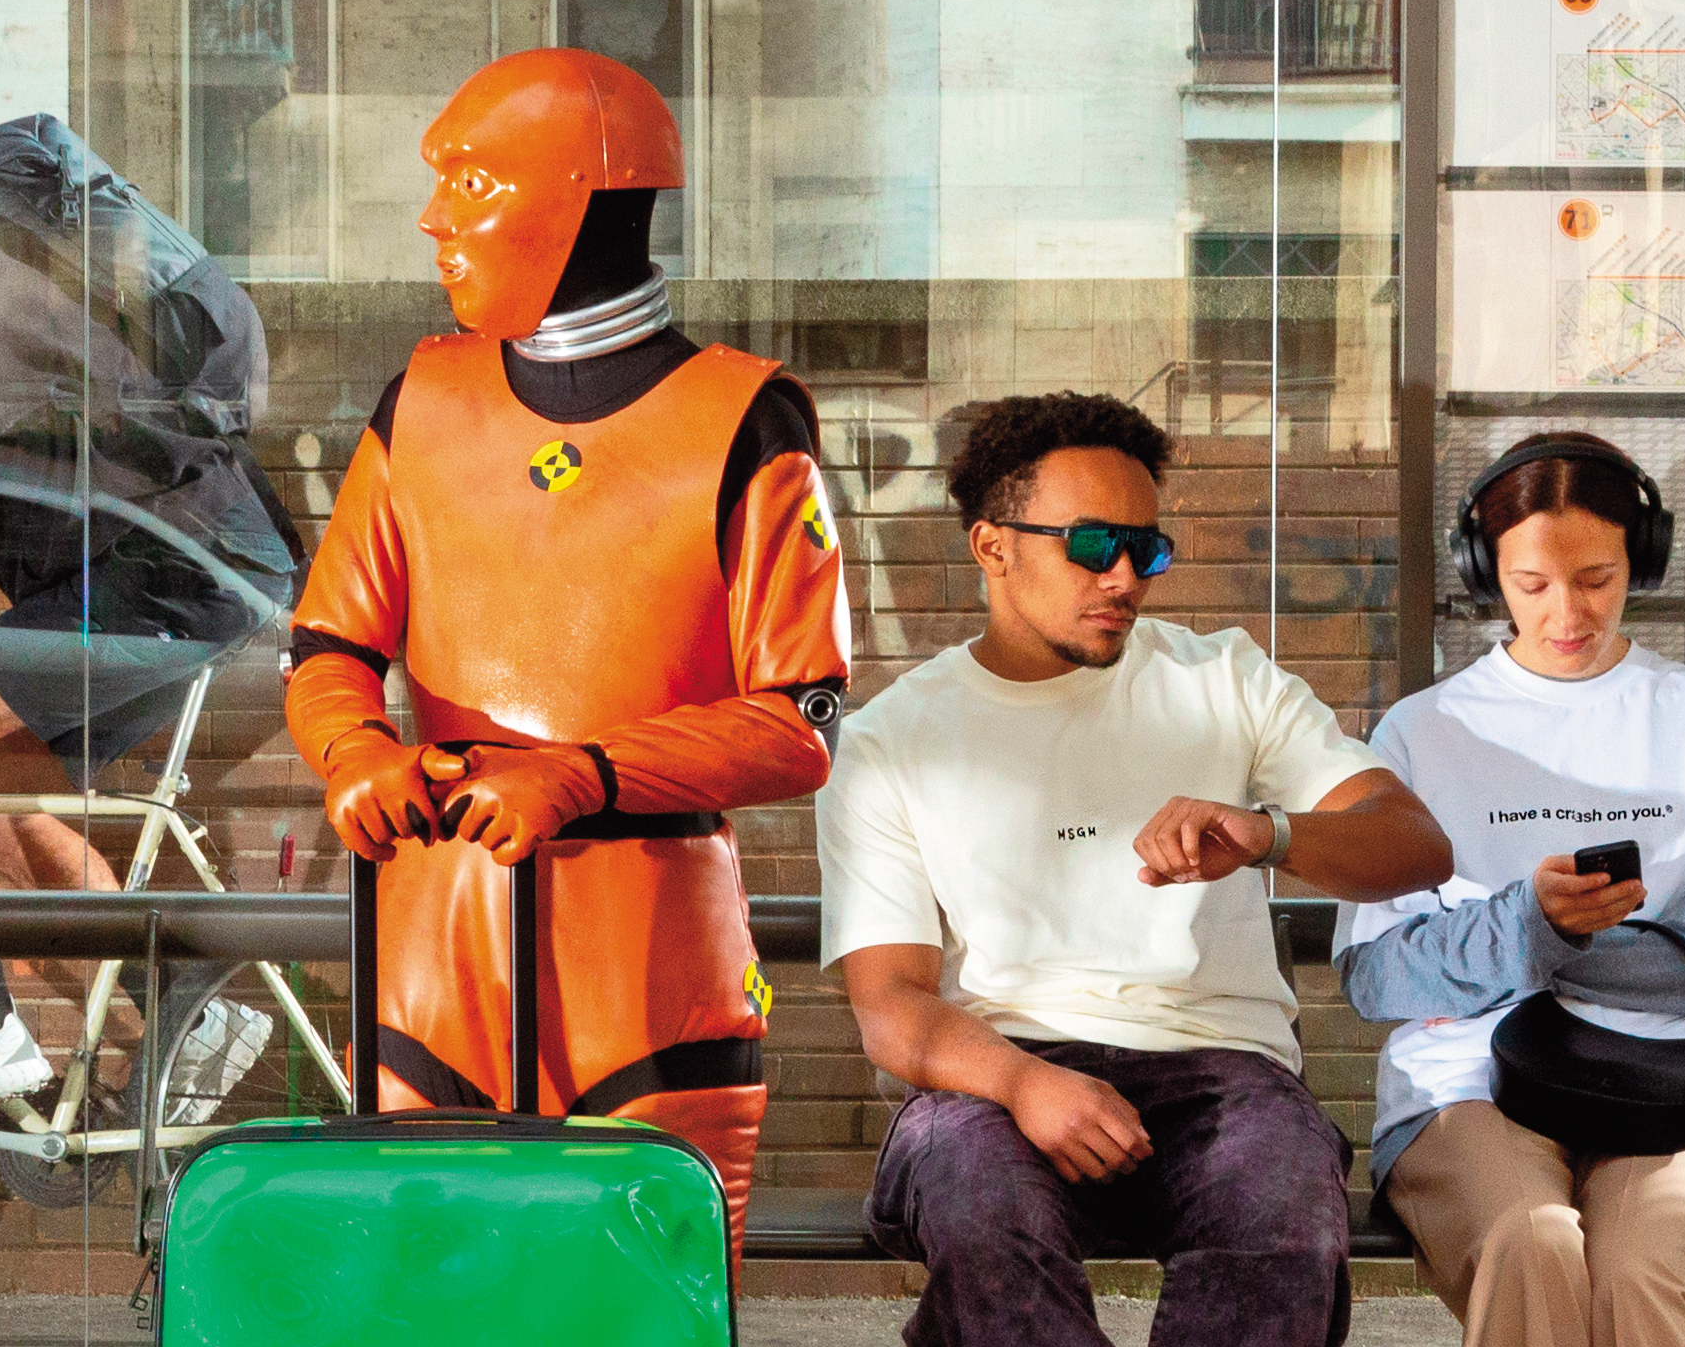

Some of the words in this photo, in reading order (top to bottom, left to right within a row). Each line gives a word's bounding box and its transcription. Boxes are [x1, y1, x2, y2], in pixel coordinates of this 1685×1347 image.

[1564, 210, 1590, 230] 71
[1489, 811, 1495, 824] I
[1498, 809, 1538, 823] have
[1542, 808, 1551, 819] a
[1606, 810, 1627, 821] on
[1057, 826, 1096, 841] MSGM
